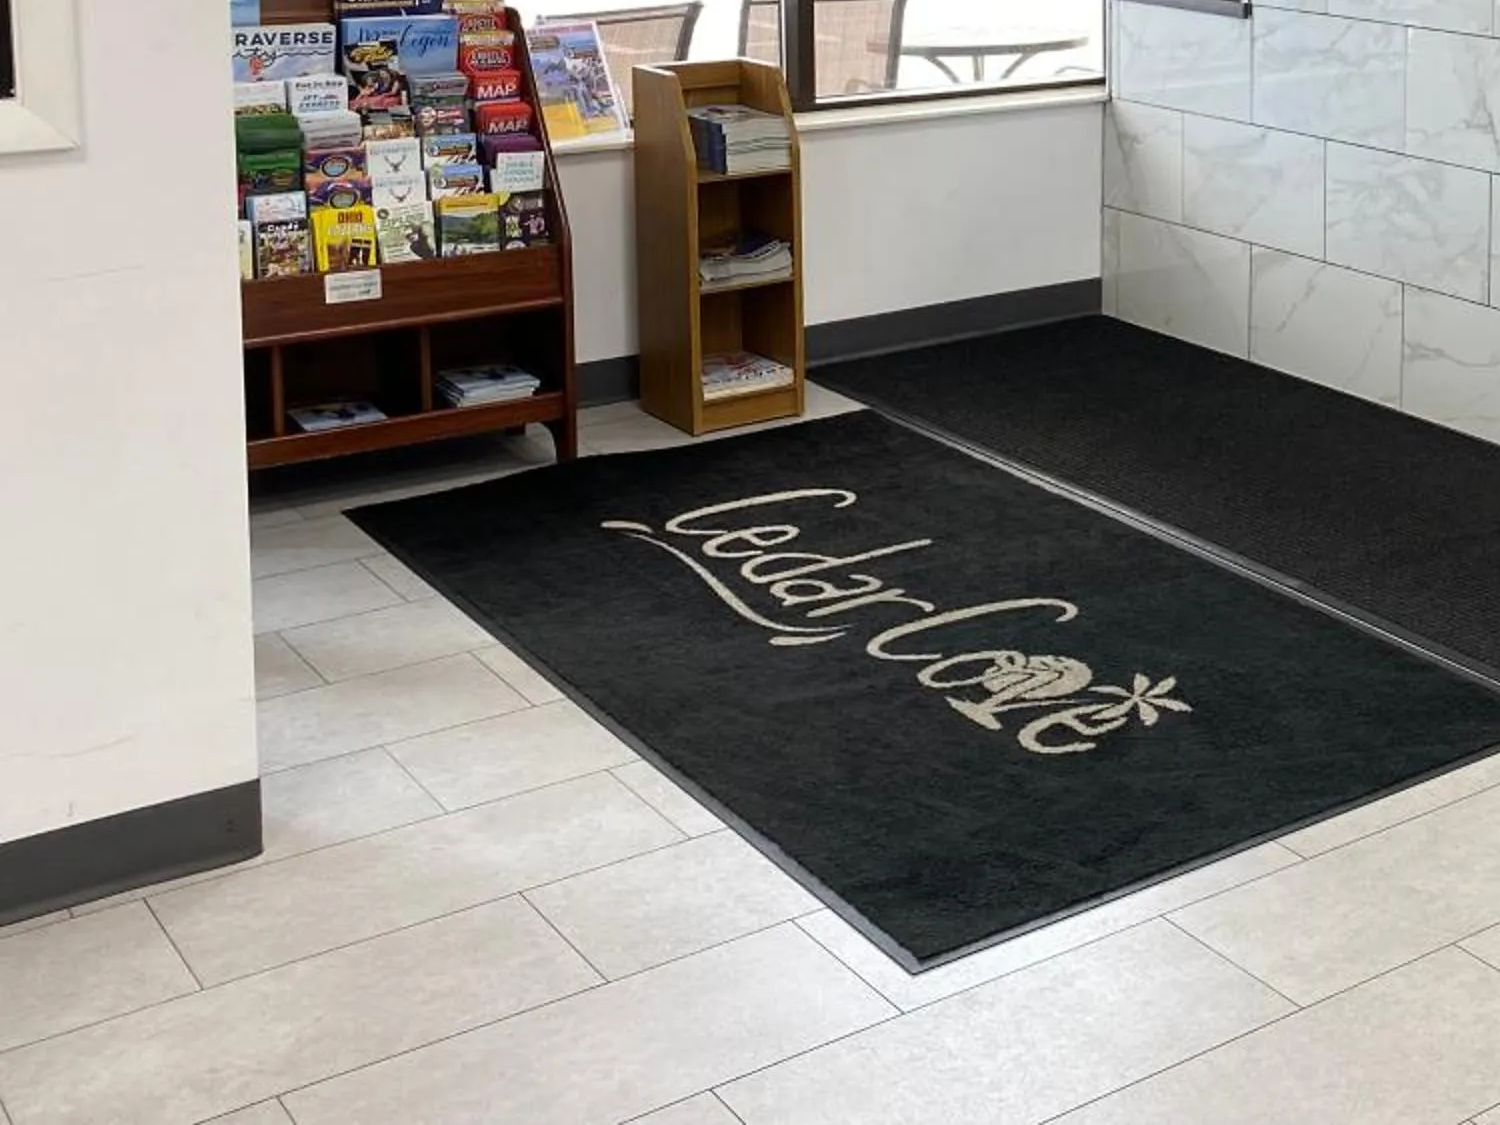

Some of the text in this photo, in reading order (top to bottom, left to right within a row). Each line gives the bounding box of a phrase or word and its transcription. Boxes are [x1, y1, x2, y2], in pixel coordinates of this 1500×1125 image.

[234, 31, 334, 47] RAVERSE
[477, 84, 517, 100] MAP
[664, 488, 1130, 755] Cedar Cove
